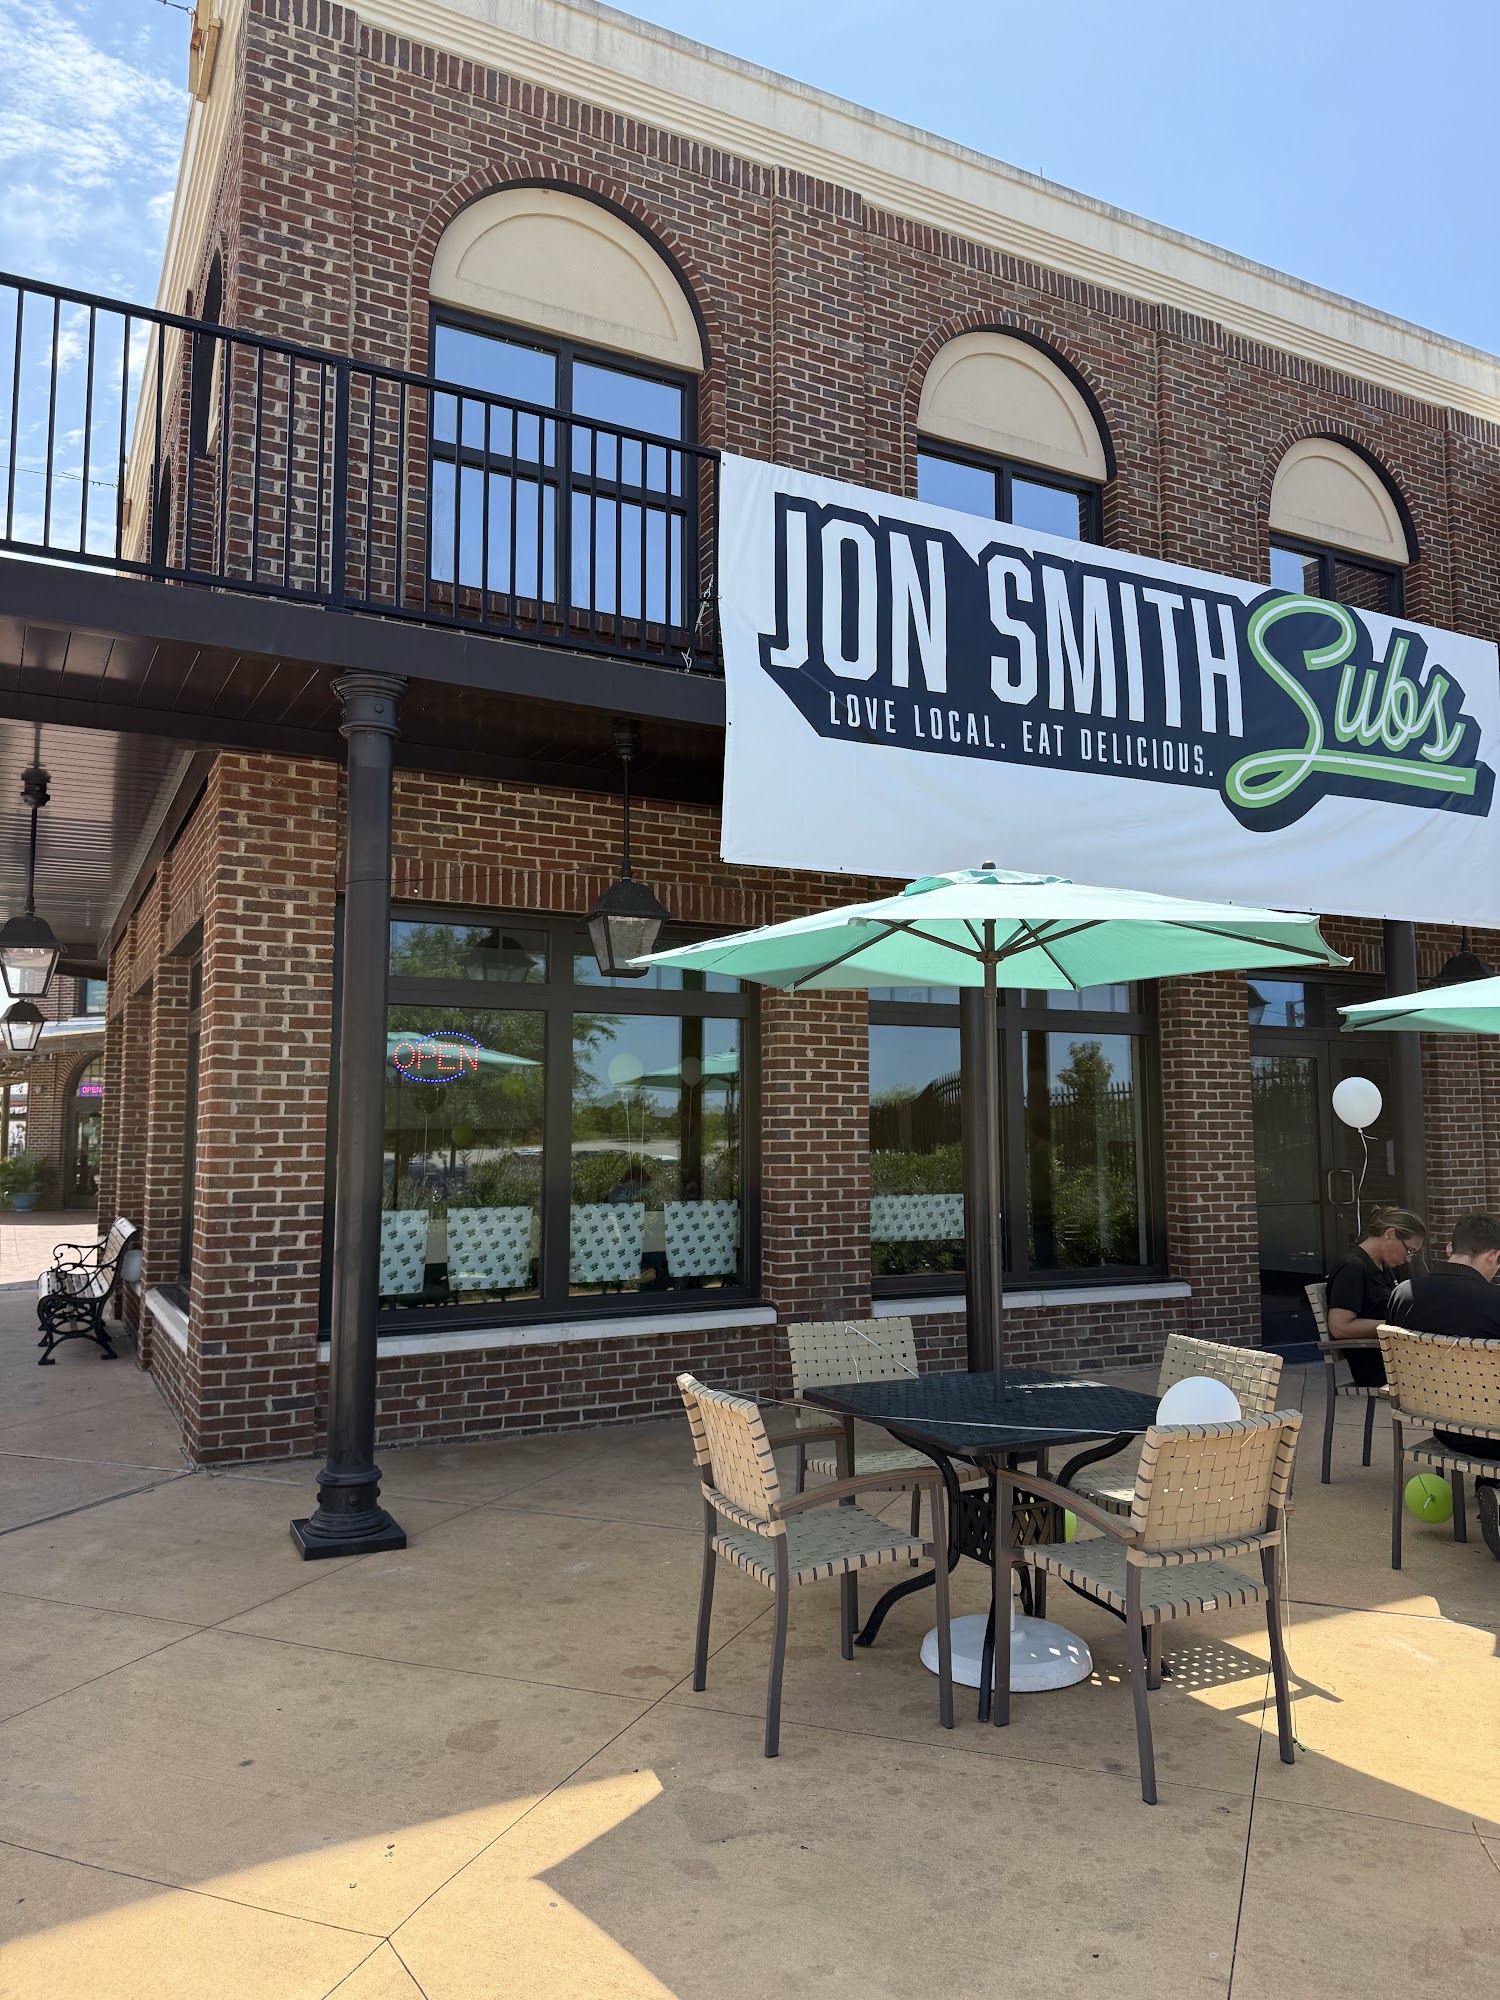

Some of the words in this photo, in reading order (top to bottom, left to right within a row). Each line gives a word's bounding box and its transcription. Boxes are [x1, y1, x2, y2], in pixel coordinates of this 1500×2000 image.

[770, 508, 948, 694] JON
[987, 554, 1243, 738] SMITH
[1225, 594, 1478, 809] Subs
[828, 690, 897, 734] LOVE
[913, 704, 1006, 750] LOCAL.
[1022, 720, 1065, 758] EAT
[1080, 728, 1215, 777] DELICIOUS.
[393, 1042, 480, 1072] OPEN
[82, 1086, 102, 1094] OPEN
